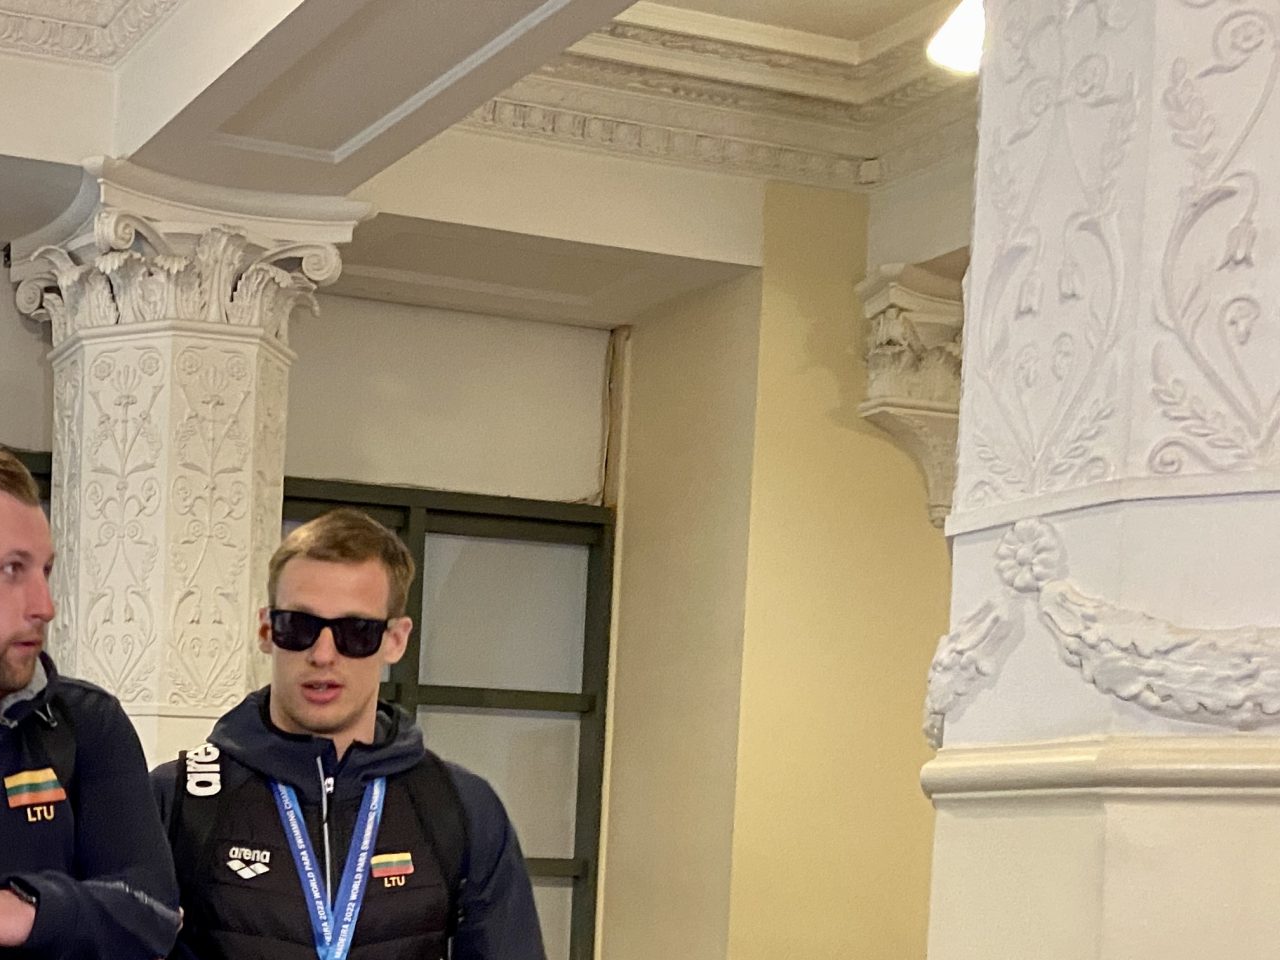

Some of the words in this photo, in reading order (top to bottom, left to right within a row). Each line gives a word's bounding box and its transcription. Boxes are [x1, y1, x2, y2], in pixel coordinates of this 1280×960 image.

[26, 805, 55, 823] LTU
[229, 845, 271, 864] arena
[384, 876, 407, 888] LTU
[344, 902, 356, 922] 2022
